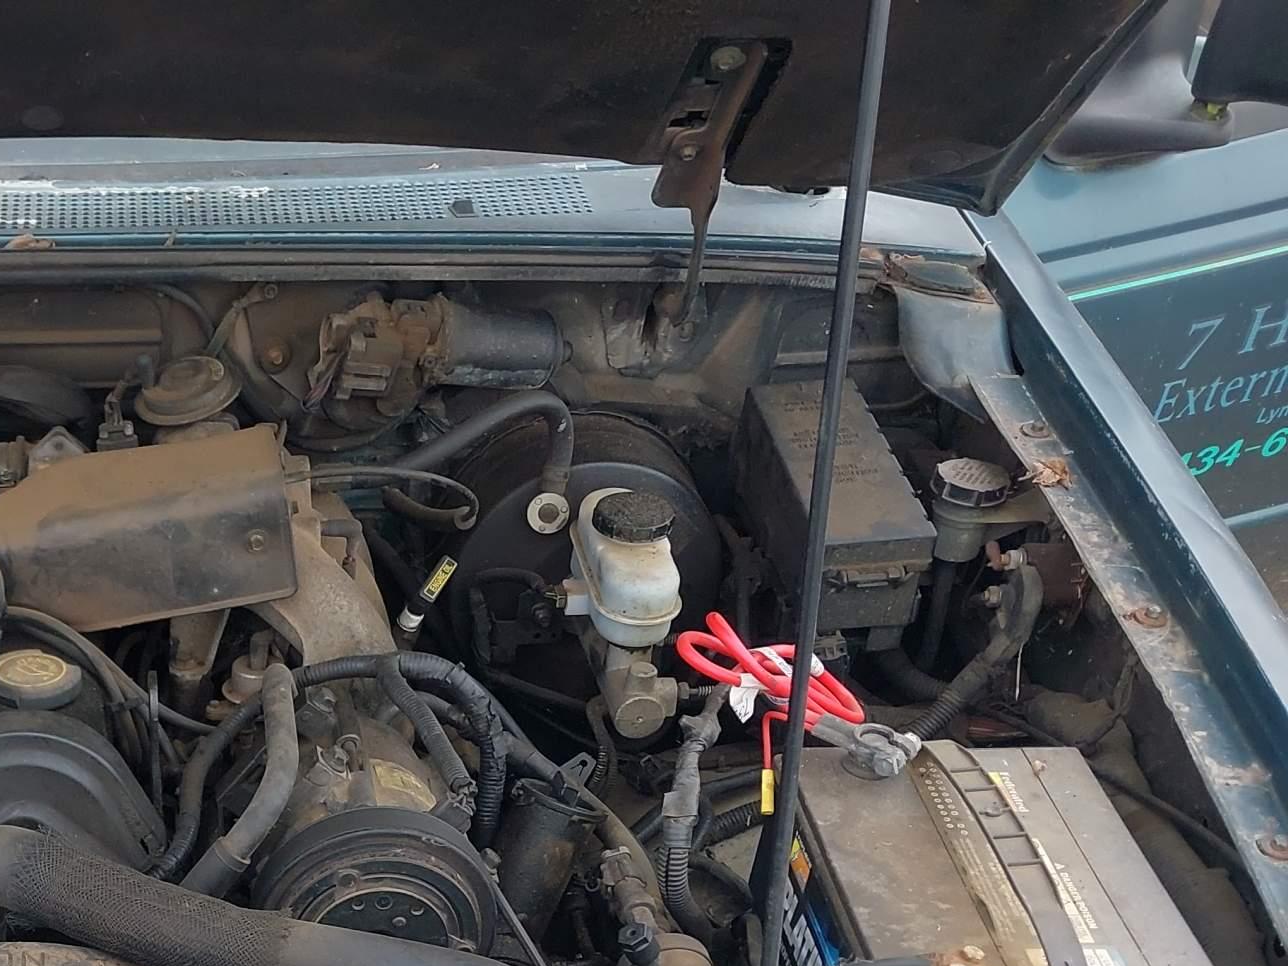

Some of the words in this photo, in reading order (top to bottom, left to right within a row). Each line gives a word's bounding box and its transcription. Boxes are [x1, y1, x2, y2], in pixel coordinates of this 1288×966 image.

[1177, 315, 1225, 371] 7
[1000, 772, 1030, 812] Federated
[1060, 872, 1082, 902] DANGER
[1076, 899, 1099, 930] POISON
